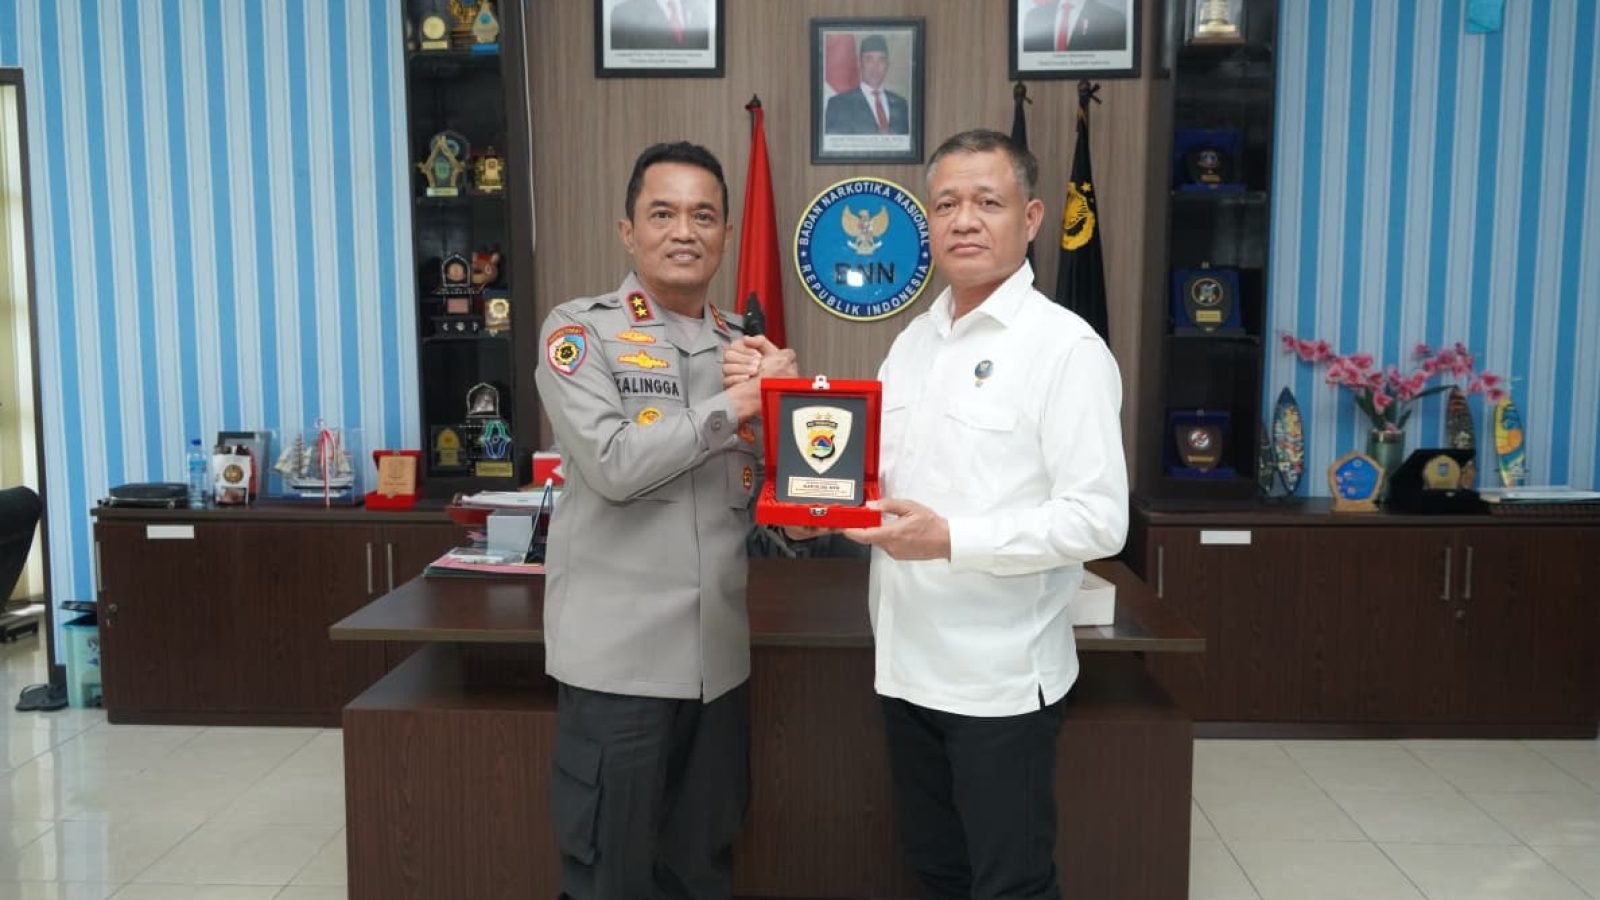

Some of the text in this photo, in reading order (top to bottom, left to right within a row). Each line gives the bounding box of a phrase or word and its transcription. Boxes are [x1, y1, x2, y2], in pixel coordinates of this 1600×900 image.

[799, 182, 929, 246] BADAN NARKOTIKA NASIONAL
[801, 264, 929, 316] REPUBLIK INDONESIA
